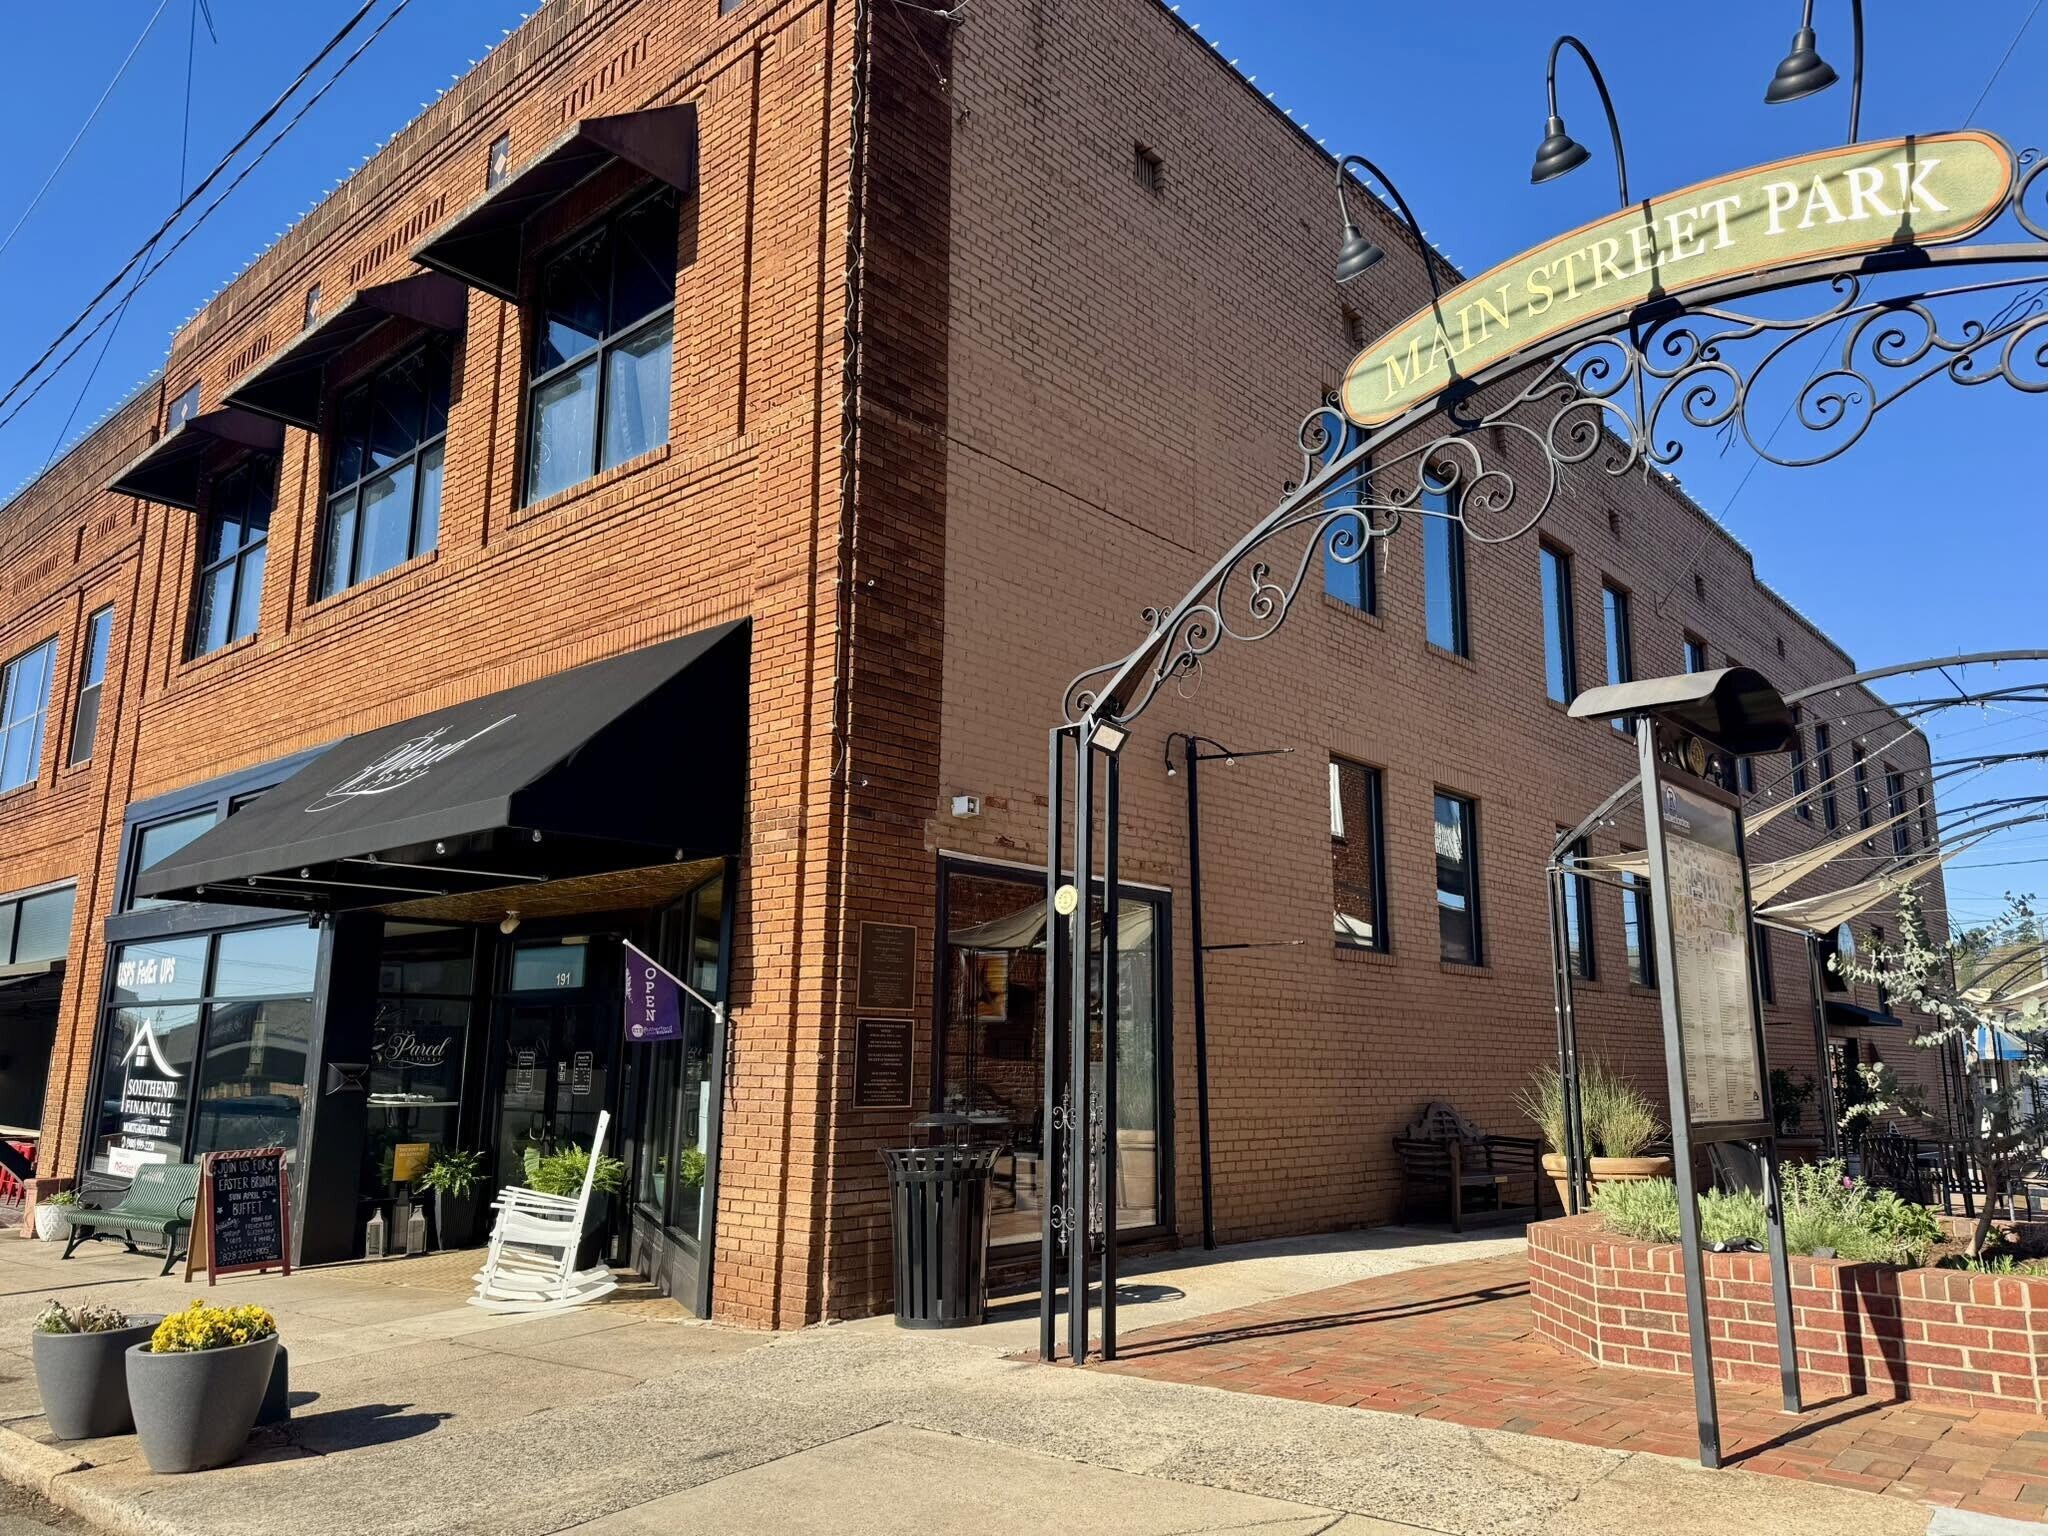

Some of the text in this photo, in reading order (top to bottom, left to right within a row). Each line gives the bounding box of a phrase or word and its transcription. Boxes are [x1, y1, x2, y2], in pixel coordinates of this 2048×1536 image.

[1381, 158, 1951, 403] MAIN STREET PARK
[117, 956, 176, 987] USPS FedEx UPS
[556, 972, 570, 986] 191
[645, 967, 657, 1021] OPEN
[385, 1033, 452, 1060] Parcel
[127, 1079, 175, 1098] SOUTHEND
[124, 1099, 172, 1117] FINANCIAL
[217, 1159, 268, 1174] JOIN US FOR
[219, 1175, 277, 1191] EASTER BRUNCH
[229, 1193, 242, 1201] SUN
[243, 1191, 261, 1200] APRIL
[232, 1201, 263, 1216] BUFFET
[222, 1250, 237, 1262] 828
